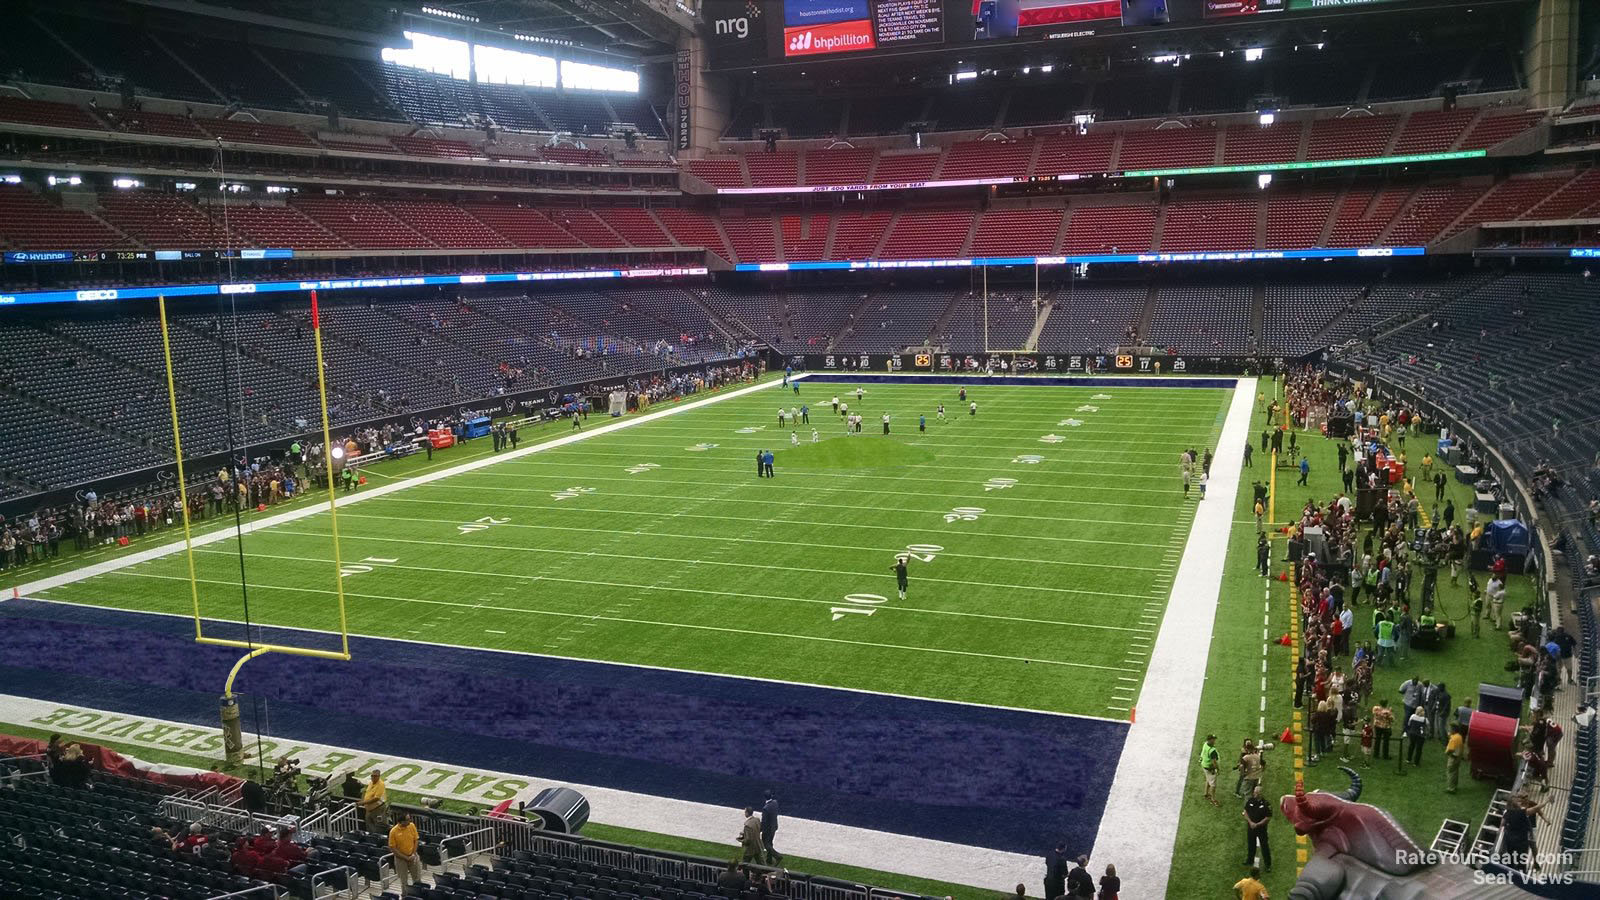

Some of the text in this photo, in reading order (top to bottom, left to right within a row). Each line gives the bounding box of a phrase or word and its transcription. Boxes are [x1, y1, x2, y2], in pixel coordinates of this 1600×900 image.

[800, 7, 854, 17] houstonmethodist.org
[715, 18, 748, 38] nrg
[814, 34, 870, 50] bhpbilliton
[1358, 248, 1392, 256] GEICO
[362, 280, 386, 288] savings
[76, 290, 118, 300] GEICO
[826, 358, 836, 366] 56
[892, 358, 902, 366] 76
[918, 356, 929, 366] 25
[1070, 360, 1080, 368] 25
[1118, 356, 1131, 366] 25
[1141, 361, 1150, 369] 17
[1174, 361, 1186, 370] 29
[520, 398, 544, 406] TEXANS
[458, 516, 512, 534] 20
[831, 593, 889, 619] 10
[31, 708, 226, 751] SERVICE
[307, 752, 530, 800] SALUTE
